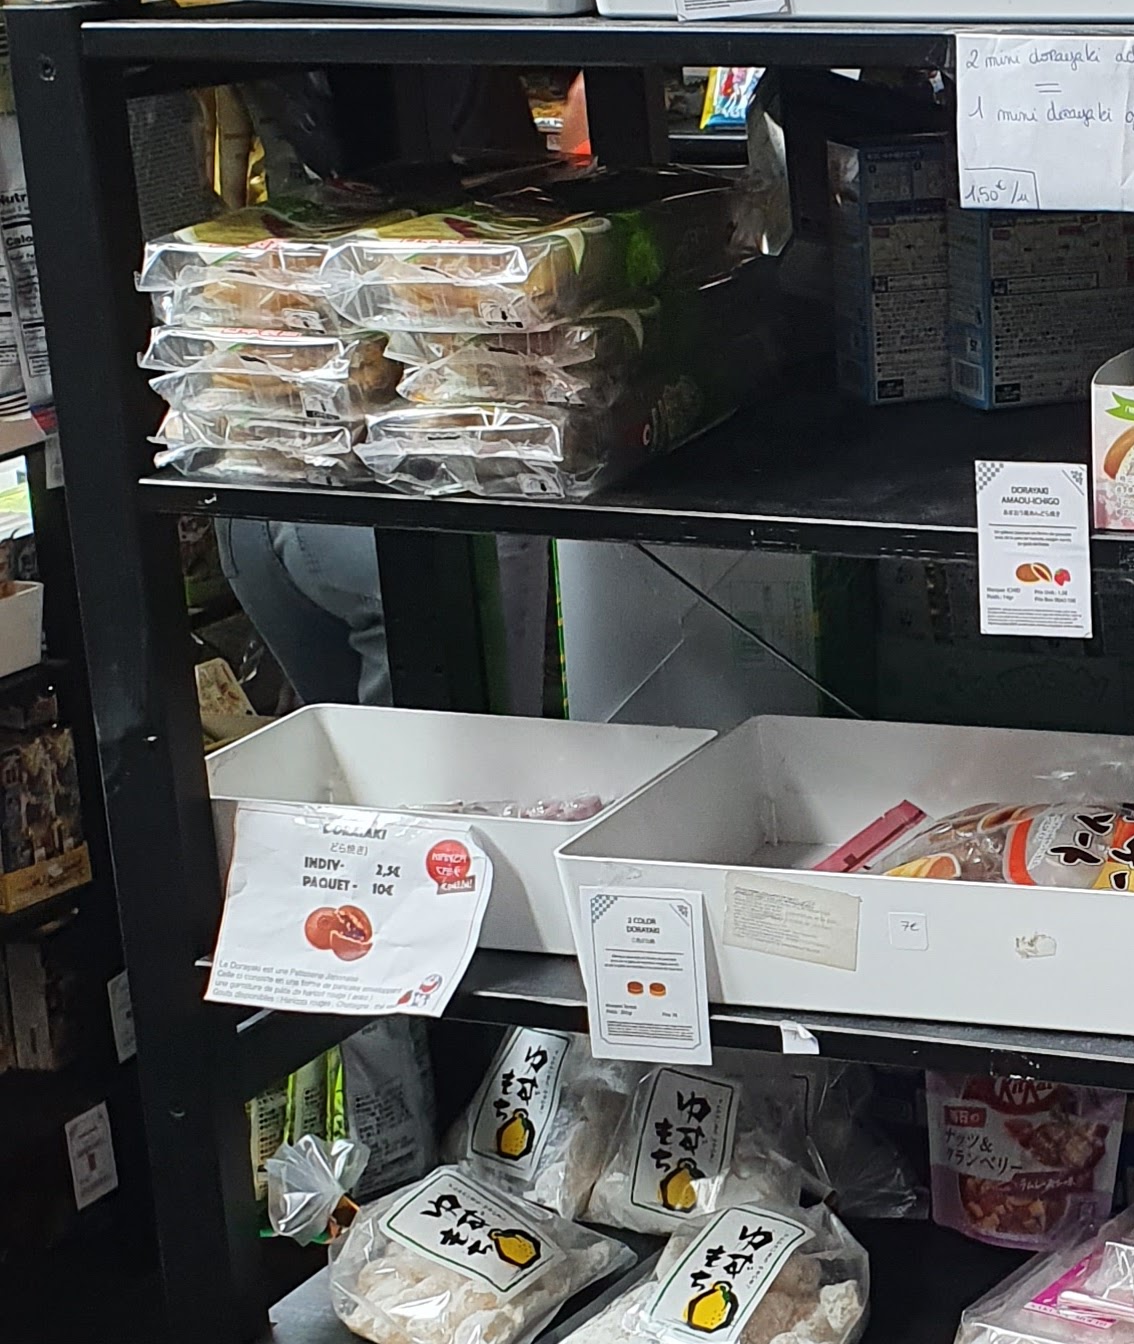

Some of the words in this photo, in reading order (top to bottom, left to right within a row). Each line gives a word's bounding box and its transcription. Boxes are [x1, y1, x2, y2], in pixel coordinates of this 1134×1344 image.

[965, 49, 979, 69] 2
[985, 51, 1020, 65] mini
[1029, 44, 1101, 71] dorayaki
[969, 95, 983, 119] 1
[997, 106, 1038, 121] mini
[1047, 101, 1112, 126] dorayaki
[1011, 486, 1049, 494] DORAYAKI
[302, 875, 350, 892] PAQUET
[372, 883, 394, 896] 10€
[492, 1069, 515, 1122] もち
[516, 1045, 549, 1106] ゆず
[651, 1118, 674, 1173] もち
[676, 1090, 712, 1156] ゆず
[945, 1148, 1024, 1174] クランベリー
[690, 1245, 726, 1290] もち
[722, 1225, 774, 1279] ゆず
